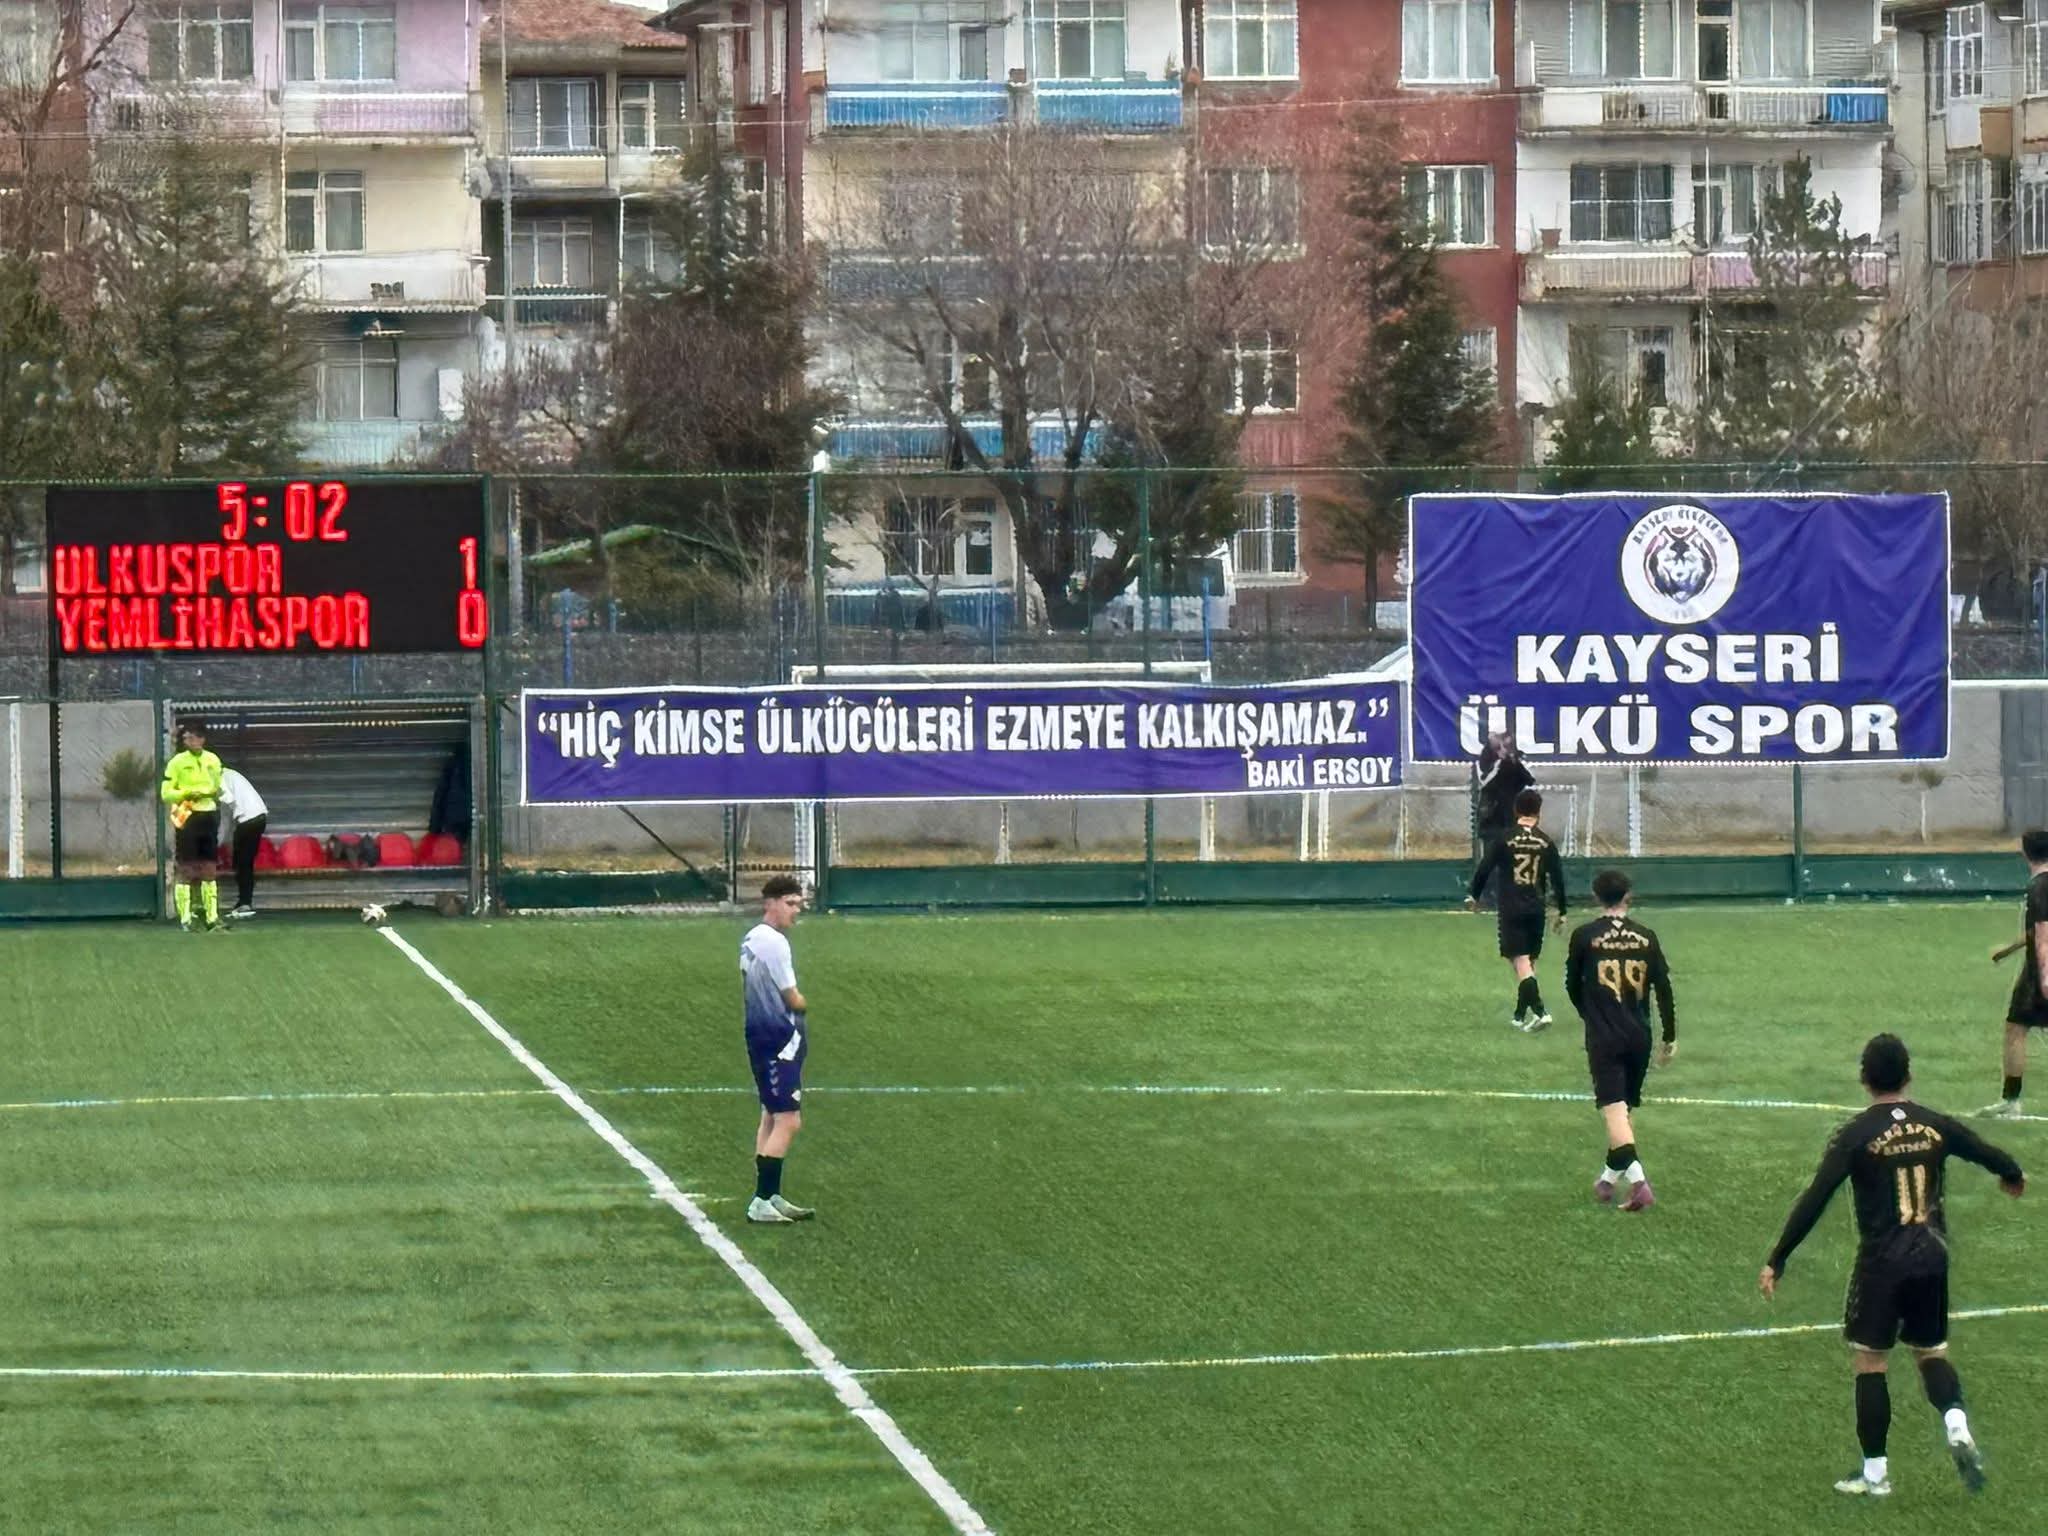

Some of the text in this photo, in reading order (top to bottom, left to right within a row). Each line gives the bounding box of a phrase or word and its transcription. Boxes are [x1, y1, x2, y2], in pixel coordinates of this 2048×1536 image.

[458, 537, 478, 590] 1
[457, 589, 488, 648] 0
[1516, 622, 1840, 685] KAYSERİ
[634, 699, 745, 756] KİMSE
[757, 696, 974, 755] ÜLKÜCÜLERİ
[987, 703, 1127, 751] EZMEYE
[1459, 693, 1900, 755] ÜLKÜ SPOR
[1246, 754, 1394, 788] BAKİ ERSOY
[1512, 853, 1541, 886] 21
[1896, 1164, 1928, 1226] 11
